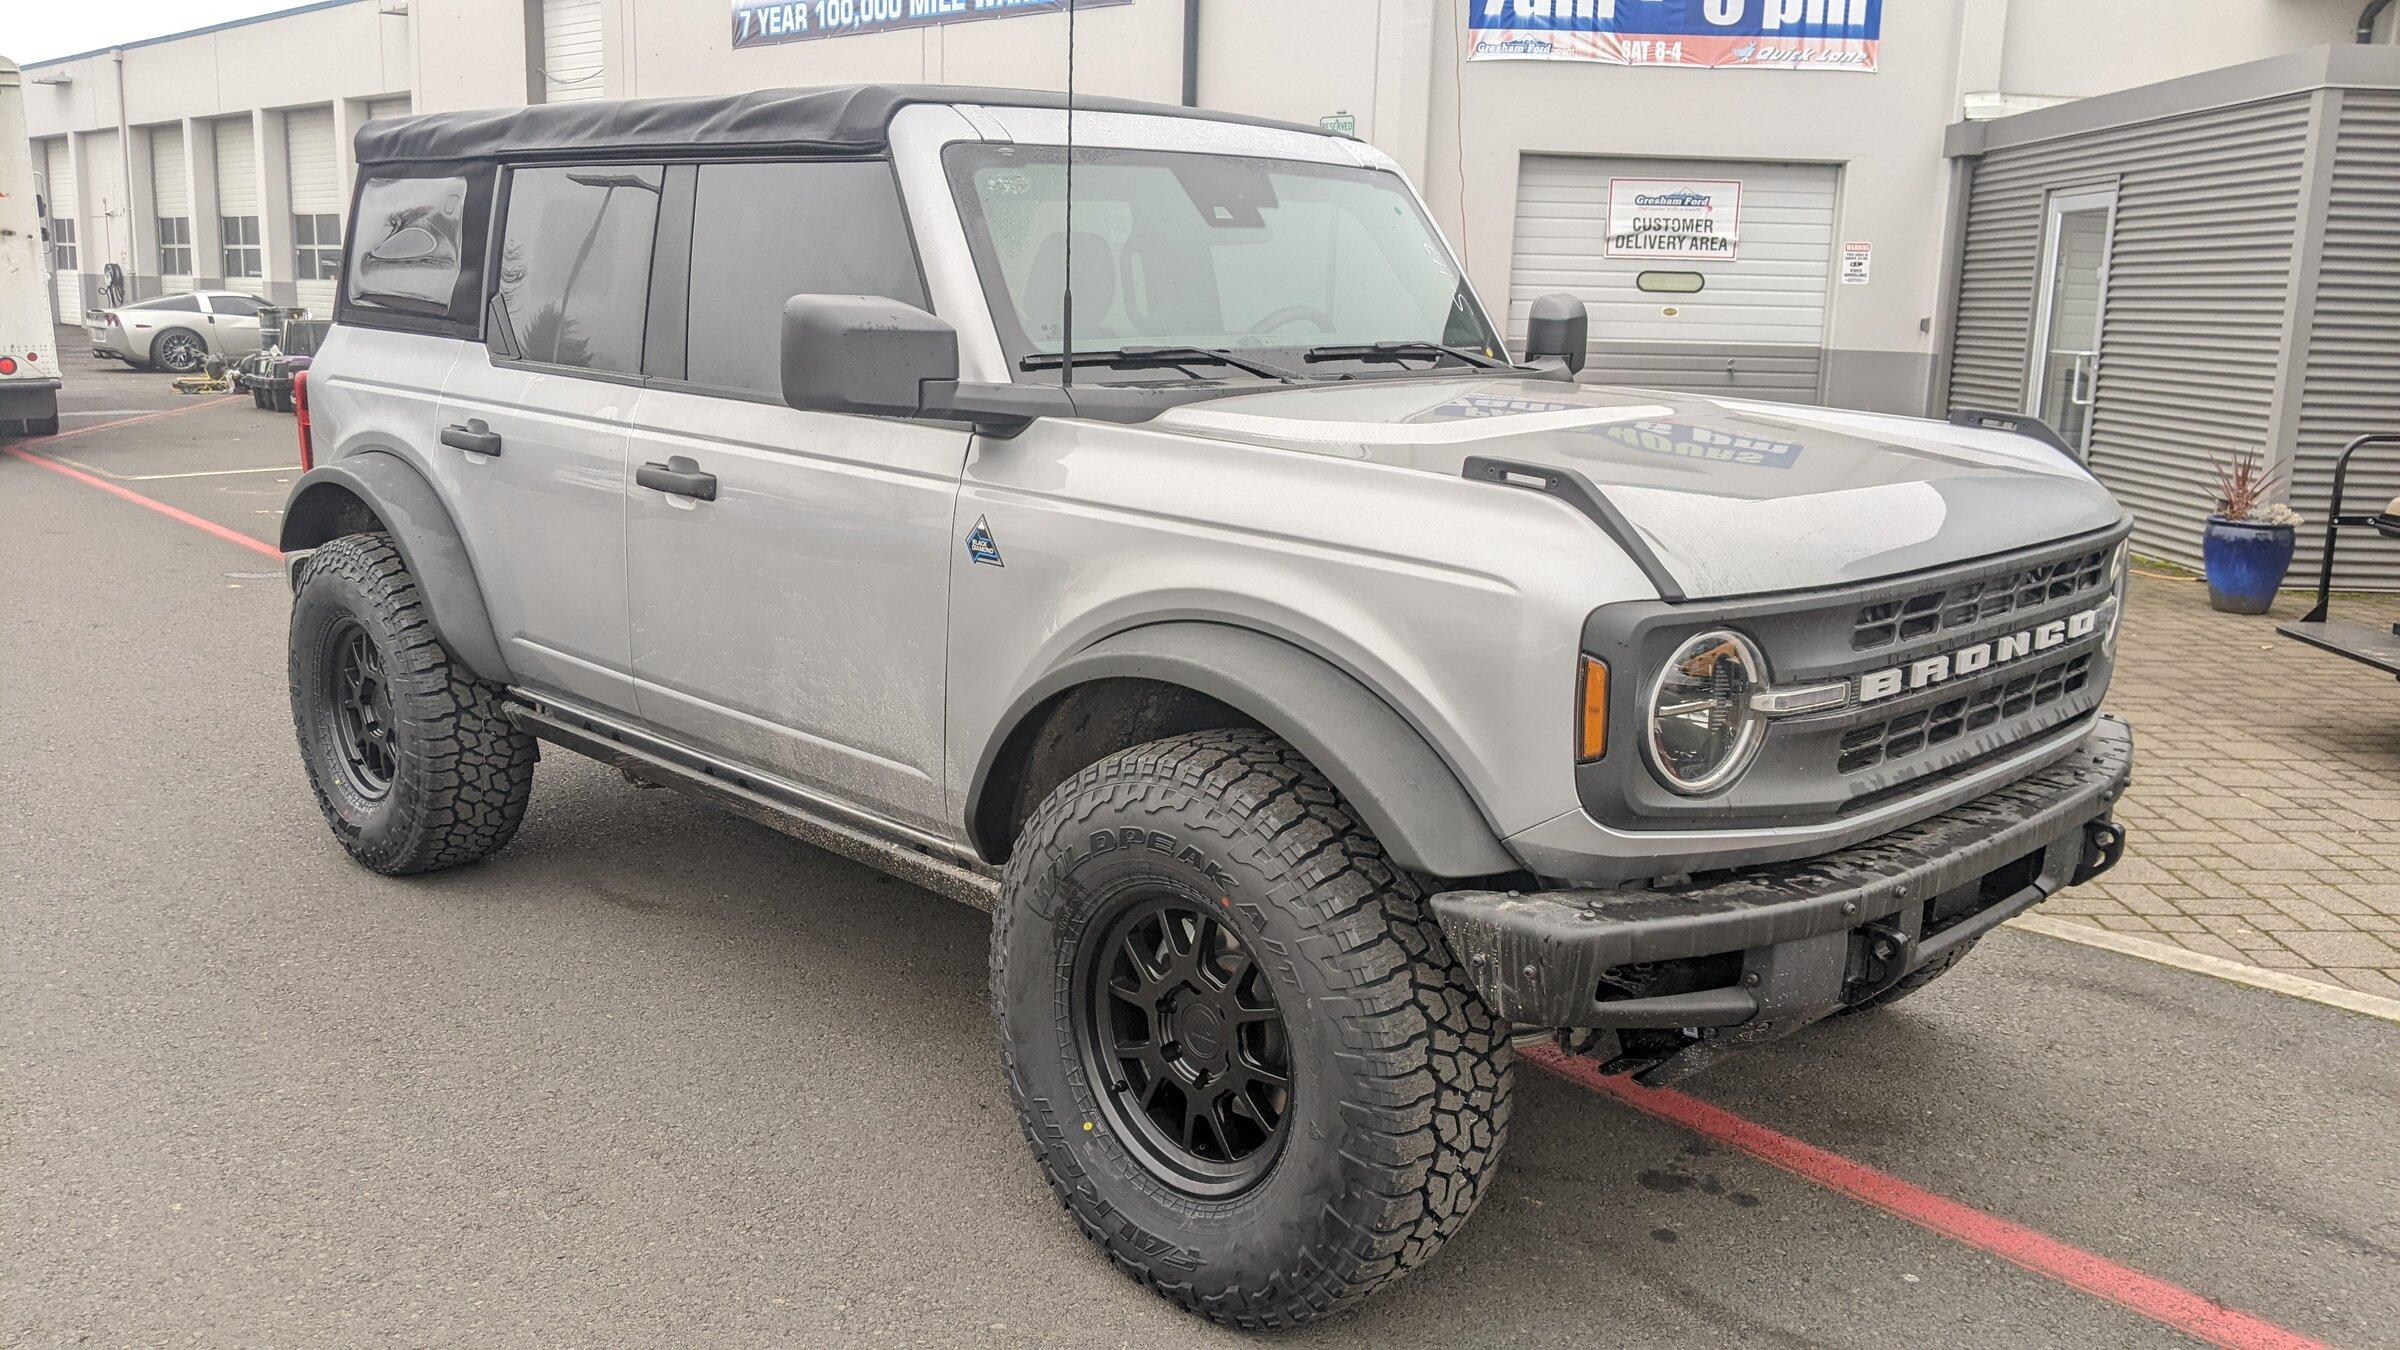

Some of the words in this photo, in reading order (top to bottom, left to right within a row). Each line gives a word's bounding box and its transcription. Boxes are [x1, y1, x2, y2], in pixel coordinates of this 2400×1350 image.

[739, 10, 751, 37] 7
[757, 2, 808, 35] YEAR
[815, 0, 901, 27] 100,000
[1476, 41, 1524, 54] Gresham
[1621, 40, 1650, 61] SAT
[1655, 41, 1682, 61] 8-4
[1755, 46, 1811, 62] Quick
[1817, 48, 1869, 63] Lane
[1635, 195, 1682, 206] Gresham
[1684, 195, 1711, 206] Ford
[1633, 217, 1714, 233] CUSTOMER
[1615, 234, 1689, 250] DELIVERY
[1689, 236, 1728, 251] AREA
[1860, 609, 2097, 702] BRONCO
